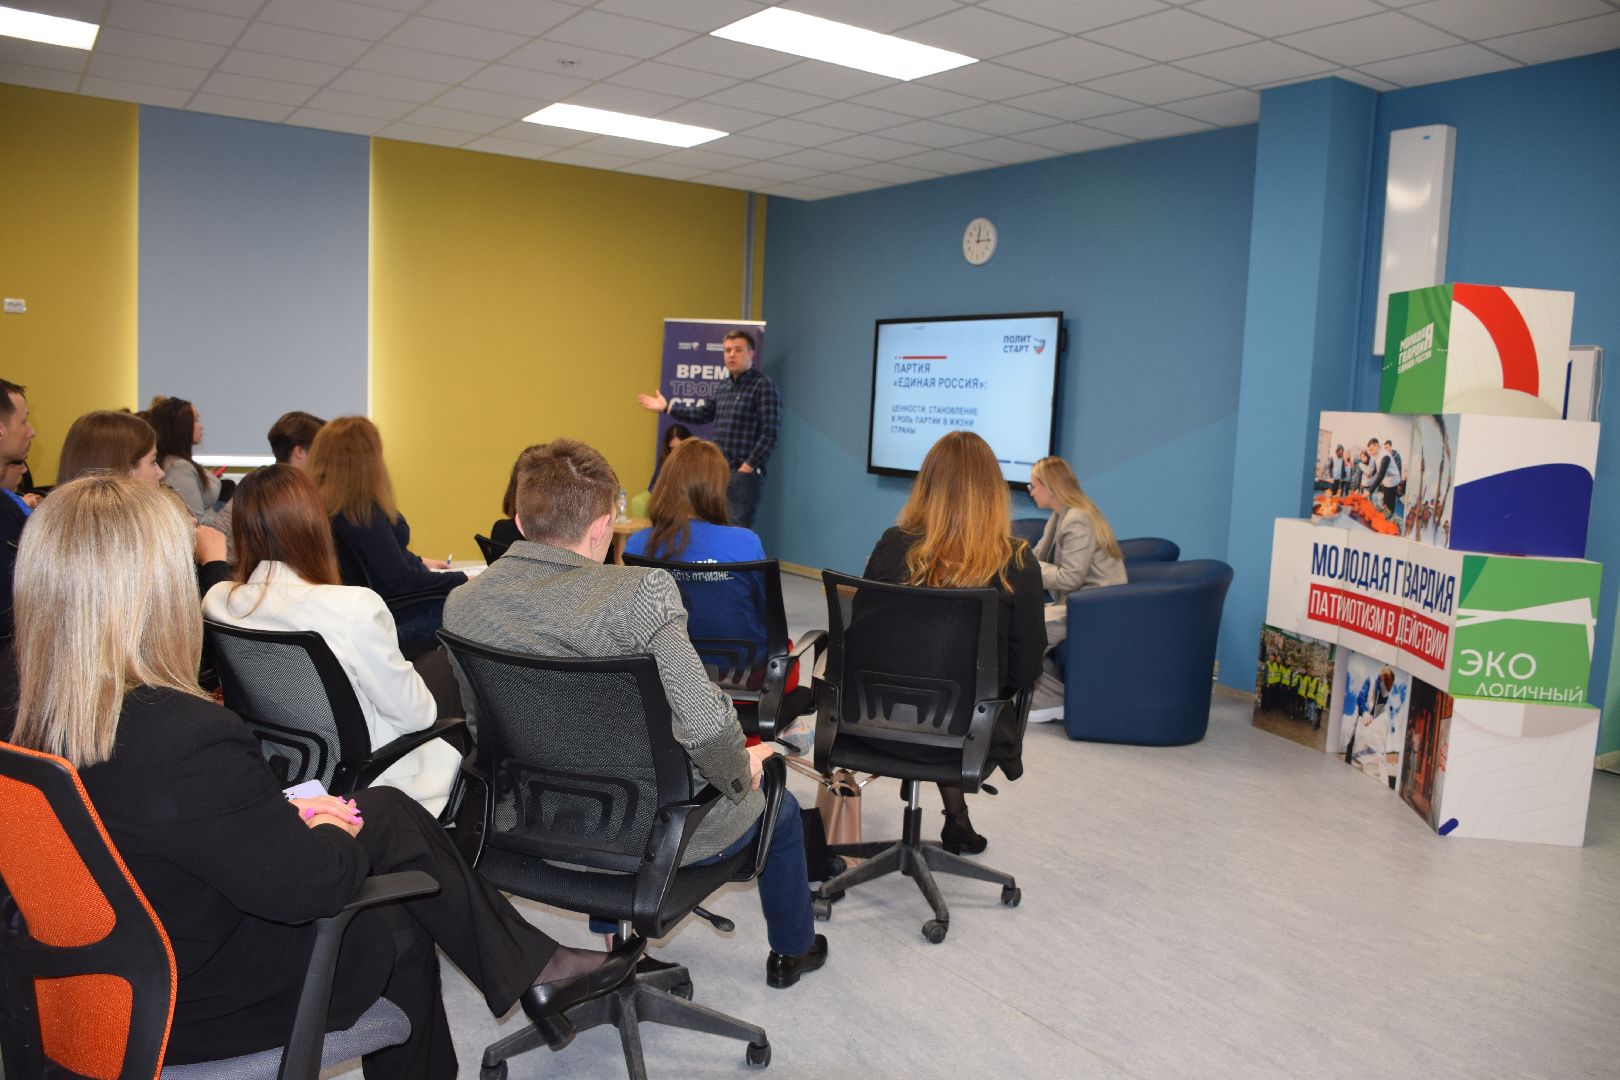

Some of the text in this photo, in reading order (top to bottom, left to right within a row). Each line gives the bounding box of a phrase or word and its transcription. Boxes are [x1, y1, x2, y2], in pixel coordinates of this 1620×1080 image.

[1003, 335, 1031, 343] ПОЛИТ
[1003, 345, 1029, 353] СТАРТ
[676, 364, 730, 380] ВРЕМ
[894, 363, 930, 374] ПАРТИЯ
[893, 377, 987, 389] «ЕДИНАЯ РОССИЯ»:
[669, 397, 706, 408] СТА
[928, 406, 978, 416] СТАНОВЛЕНИЕ
[897, 415, 913, 423] РОЛЬ
[915, 416, 941, 425] ПАРТИИ
[949, 418, 975, 427] ЖИЗНИ
[890, 426, 916, 434] СТРАНЫ
[1311, 542, 1456, 616] МОЛОДАЯ ГВАРДИЯ
[1310, 589, 1447, 662] ПАТРИОТИЗМ В ДЕЙСТВИИ
[1458, 648, 1537, 680] ЭКО
[1475, 681, 1584, 702] ЛОГИЧНЫЙ
